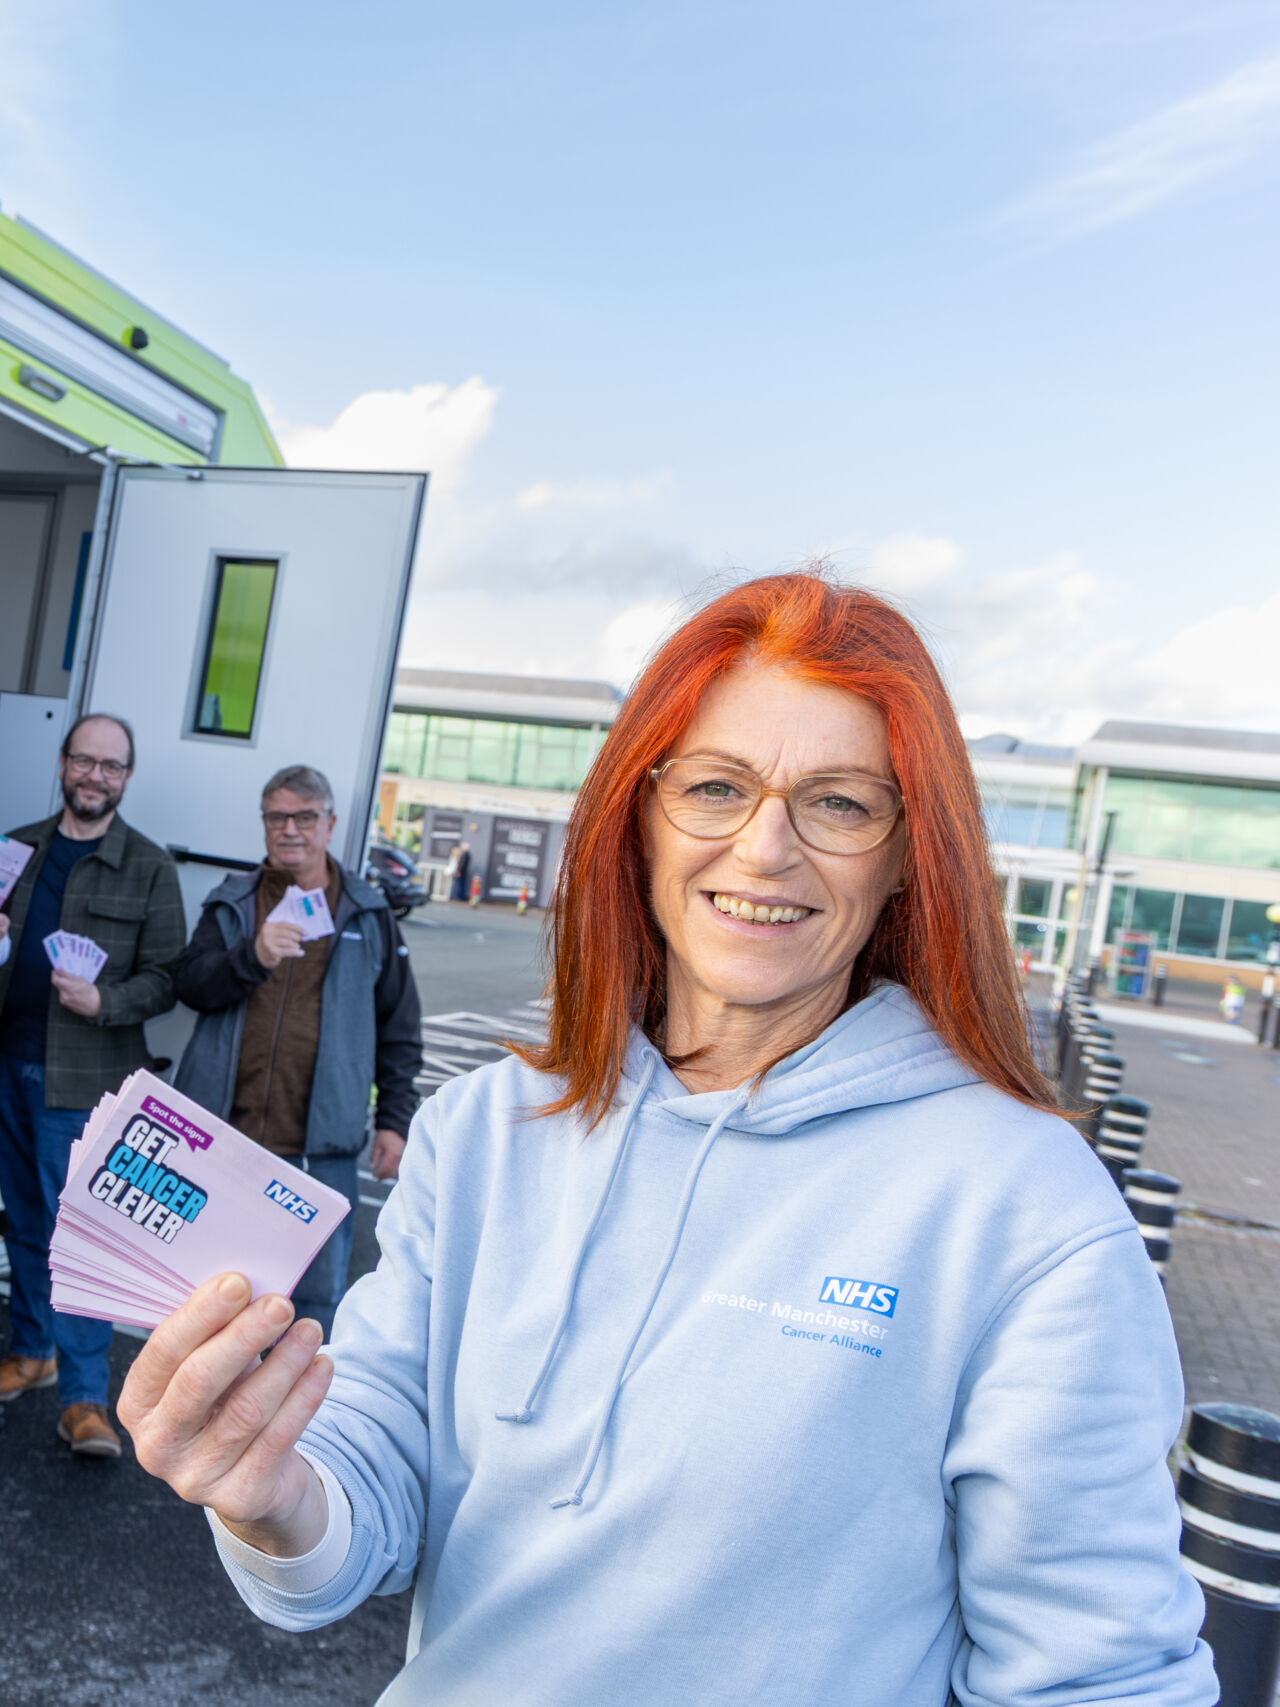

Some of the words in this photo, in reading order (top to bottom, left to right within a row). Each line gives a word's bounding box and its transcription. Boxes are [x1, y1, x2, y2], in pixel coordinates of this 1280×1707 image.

[123, 1118, 180, 1166] GET
[148, 1101, 170, 1119] Spot
[168, 1115, 184, 1129] the
[183, 1125, 206, 1143] signs
[107, 1144, 208, 1223] CANCER
[265, 1182, 318, 1222] NHS
[90, 1170, 184, 1244] CLEVER
[820, 1278, 897, 1314] NHS
[770, 1301, 889, 1340] Manchester
[781, 1324, 827, 1342] Cancer
[829, 1333, 882, 1358] Alliance
